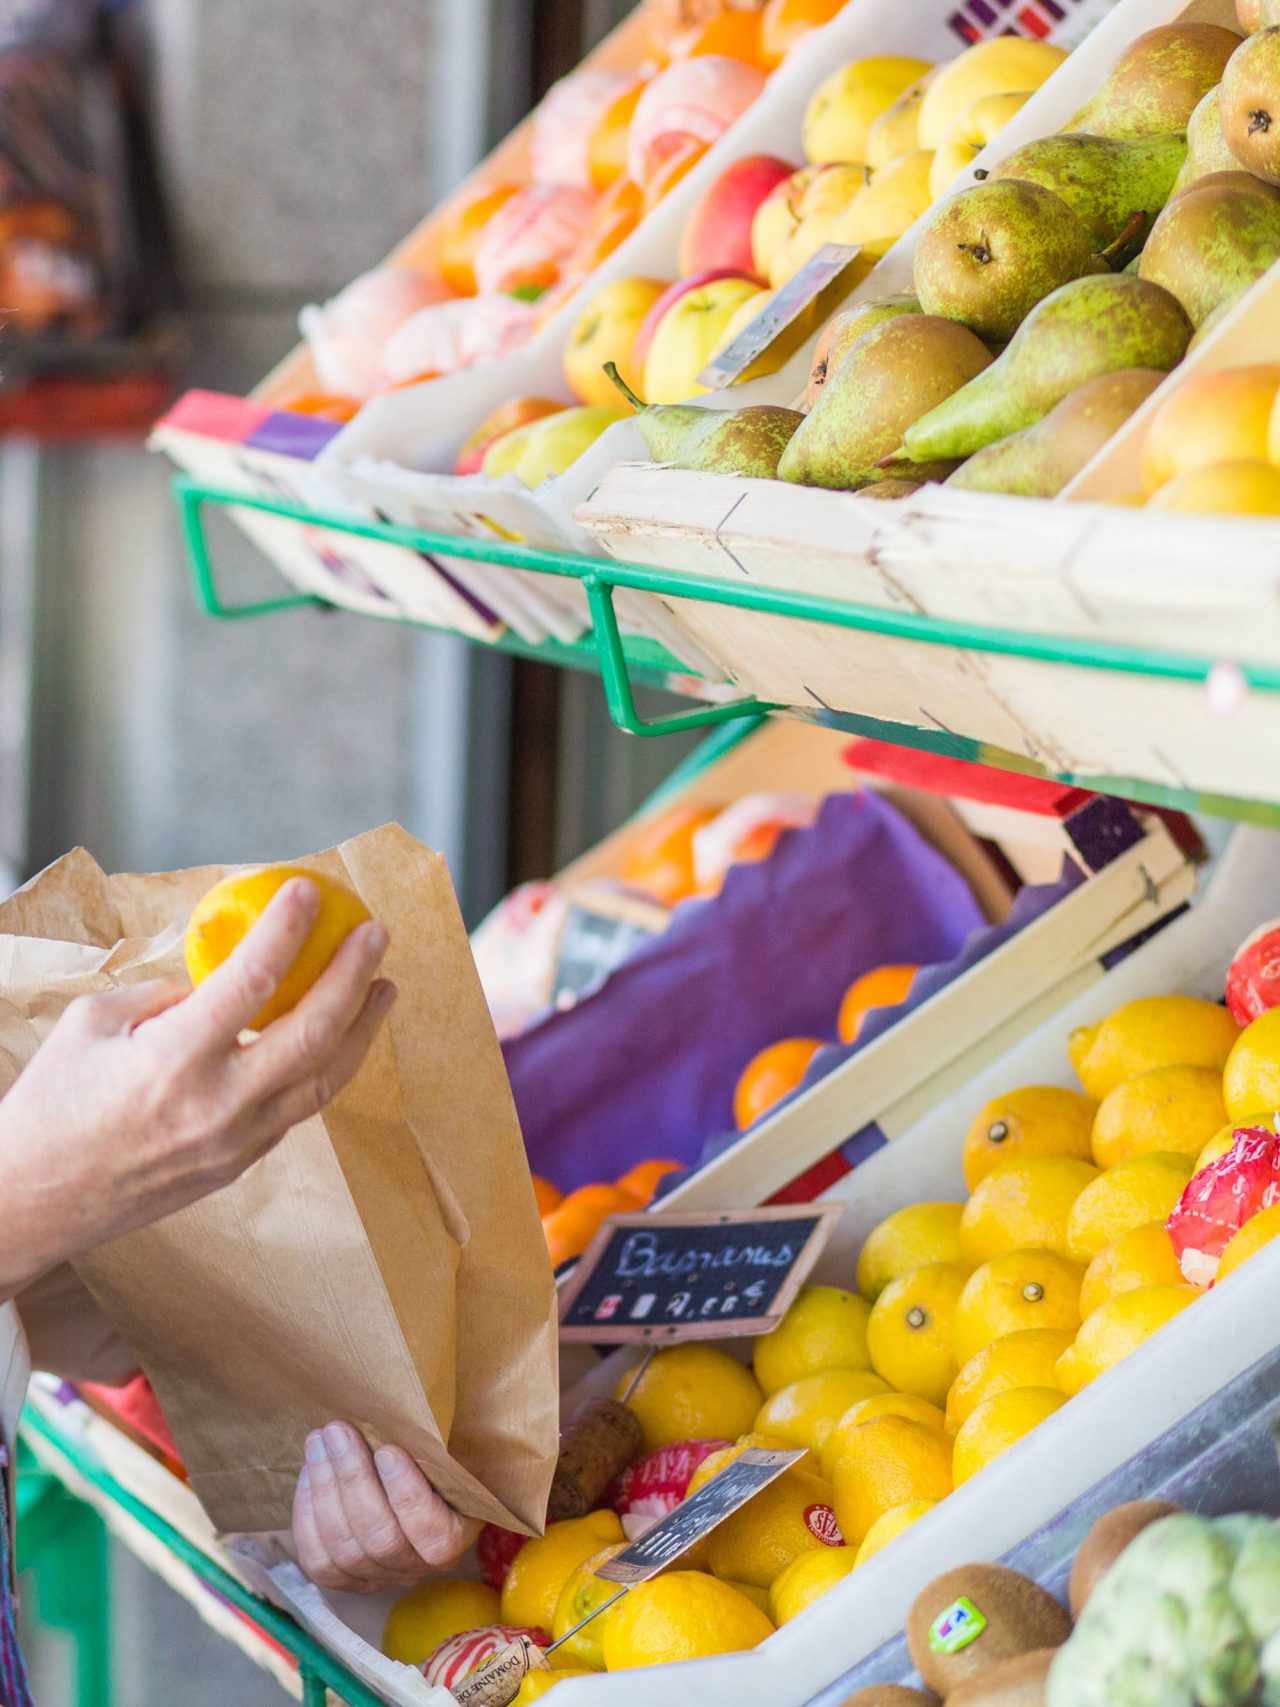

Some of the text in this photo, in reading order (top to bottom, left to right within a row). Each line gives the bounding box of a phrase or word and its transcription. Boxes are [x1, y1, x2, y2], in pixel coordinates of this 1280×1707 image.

[808, 1524, 839, 1546] ORIGINAL
[456, 1655, 521, 1704] DOMAINE DE
